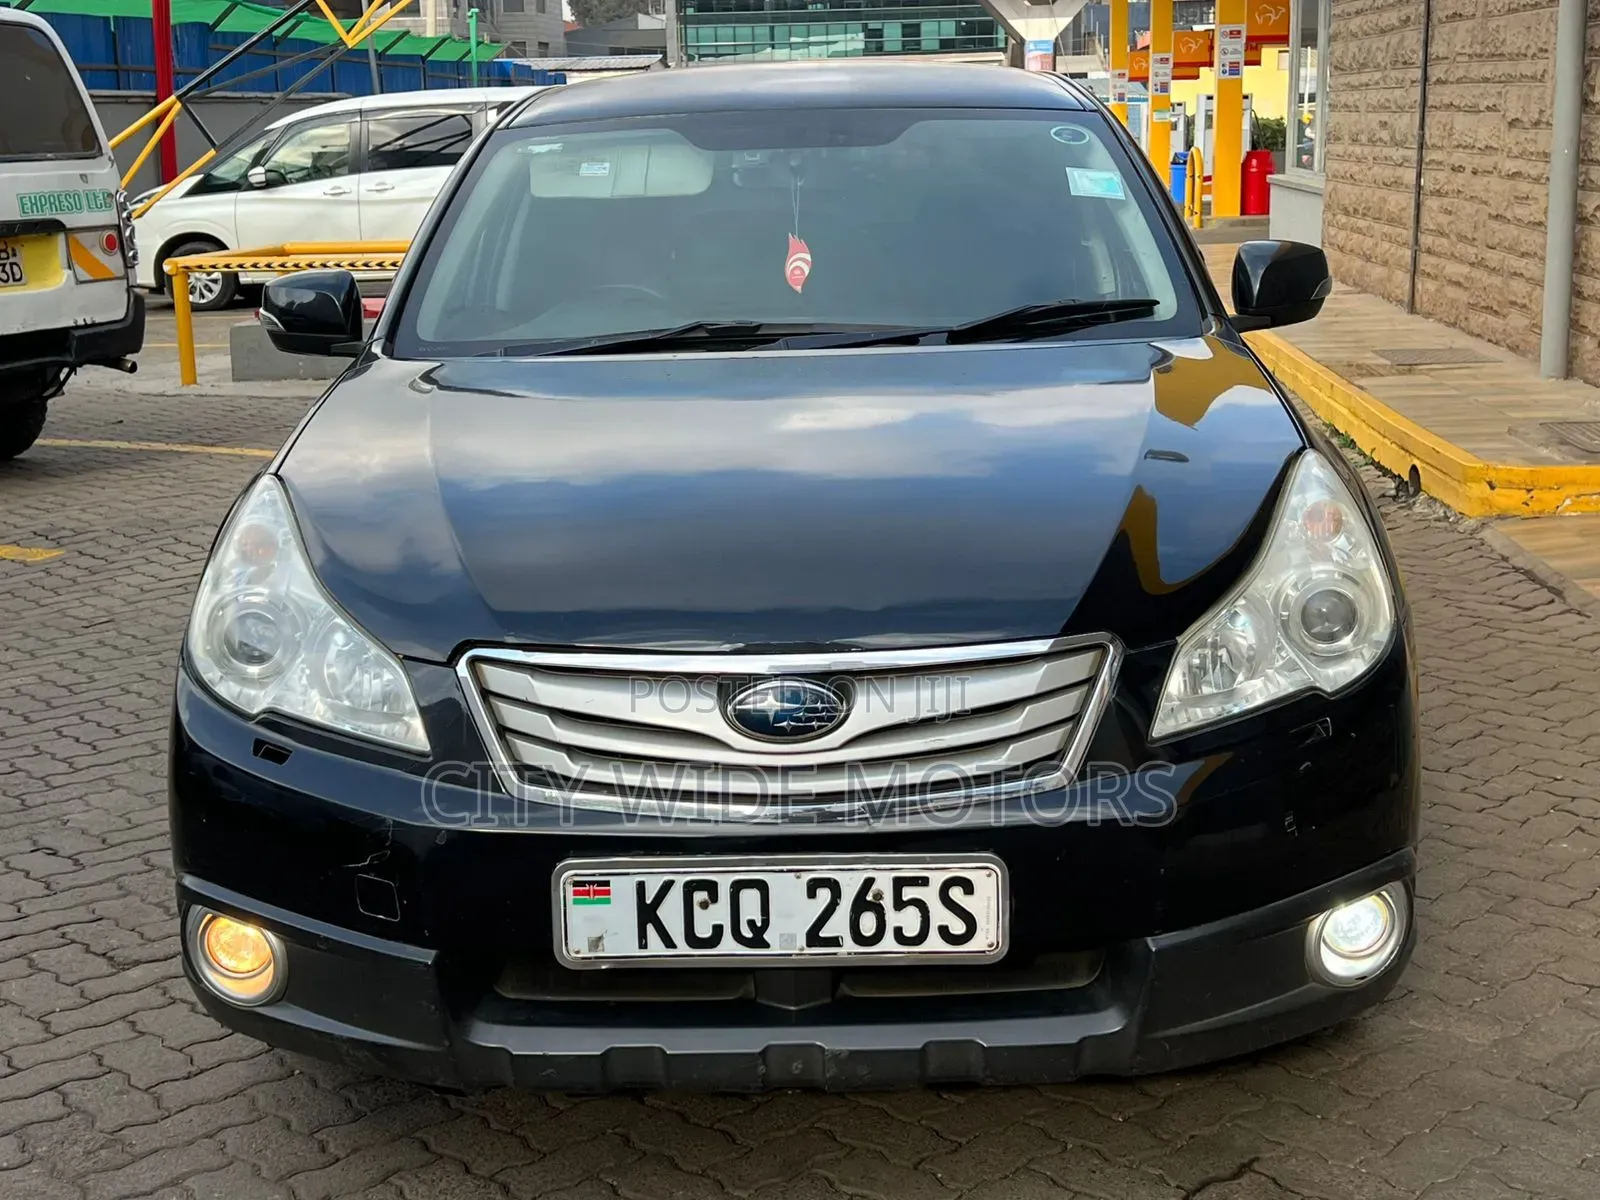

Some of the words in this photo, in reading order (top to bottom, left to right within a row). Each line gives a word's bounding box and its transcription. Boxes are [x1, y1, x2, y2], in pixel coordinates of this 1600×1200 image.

[19, 192, 83, 215] EXPRESO
[635, 877, 771, 950] KCQ
[806, 875, 978, 949] 265S
